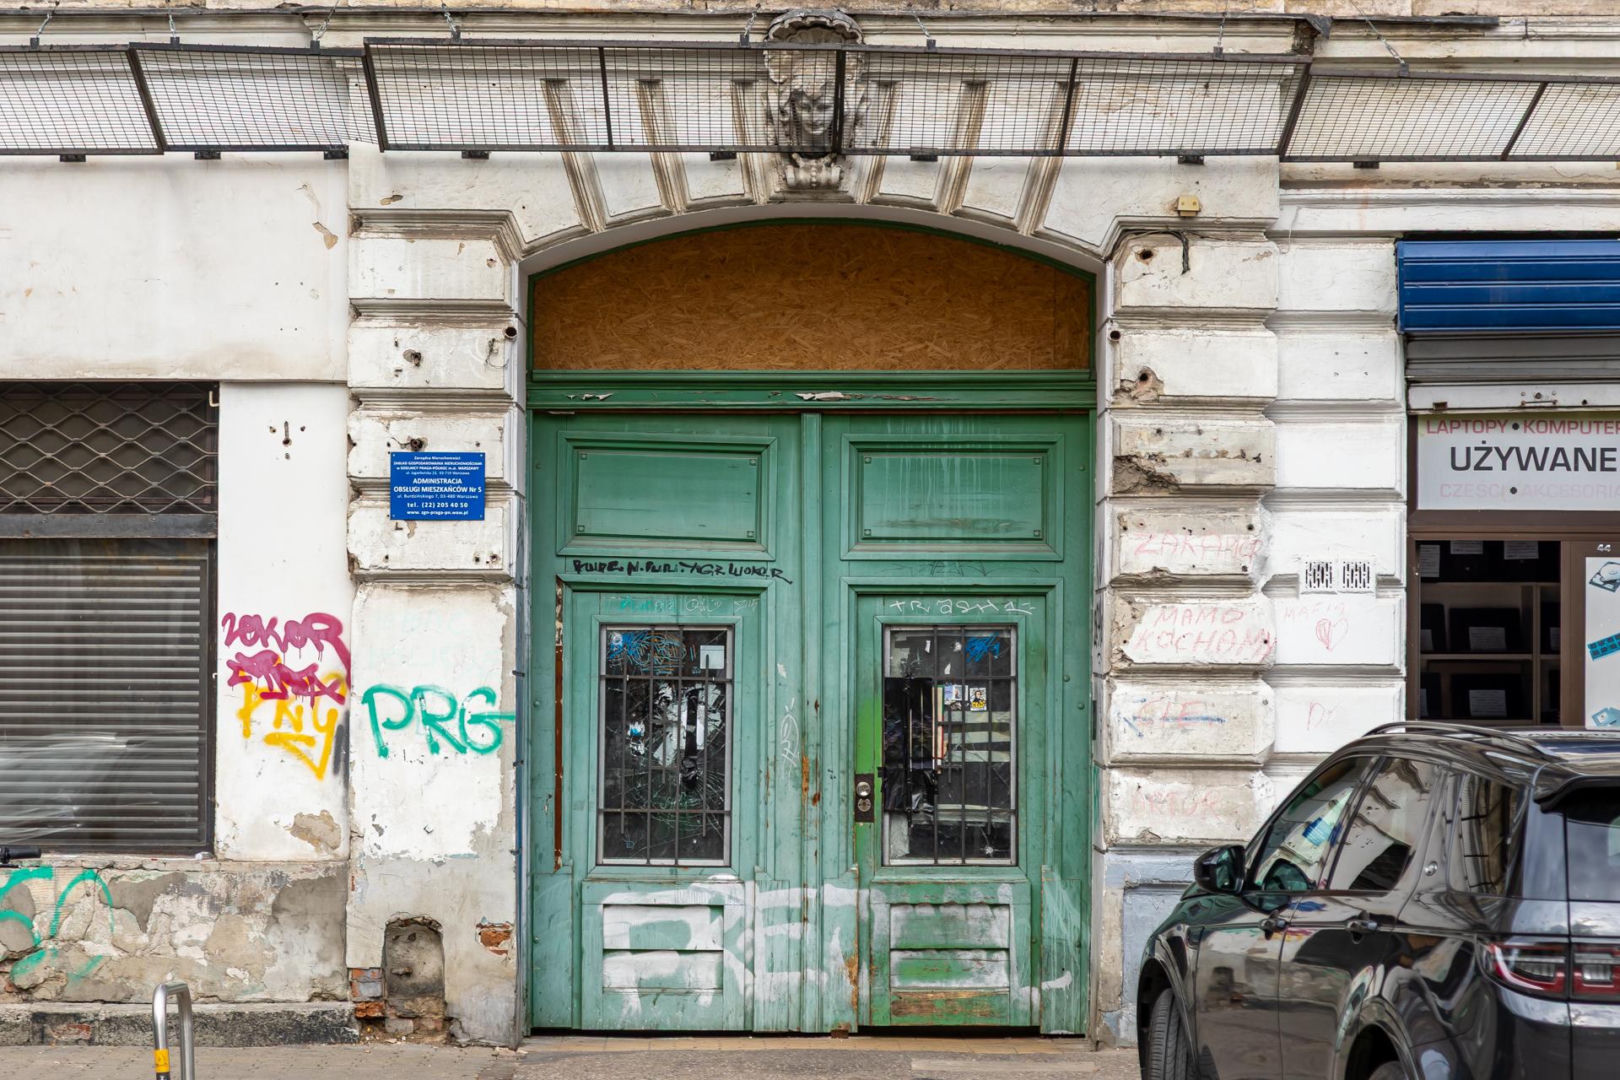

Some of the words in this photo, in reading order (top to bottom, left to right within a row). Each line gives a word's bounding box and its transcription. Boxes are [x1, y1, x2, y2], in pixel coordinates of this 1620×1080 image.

[1427, 419, 1508, 434] LAPTOPY
[1450, 440, 1617, 472] UŻYWANE
[421, 485, 467, 493] MIESZKAŃCÓW
[361, 683, 515, 758] PRG
